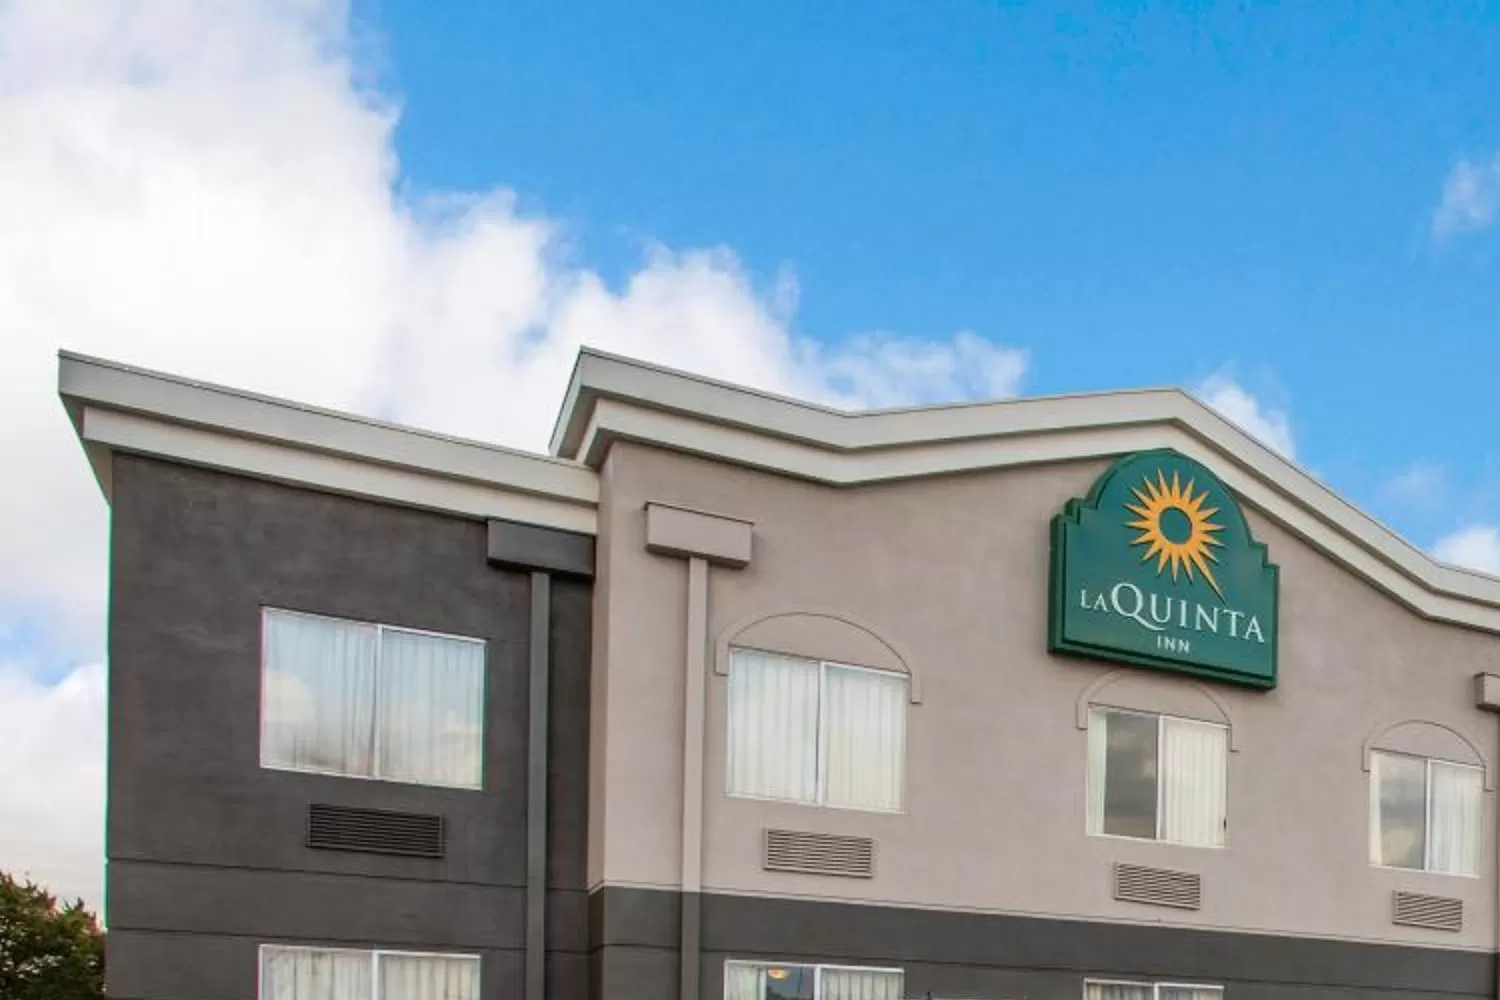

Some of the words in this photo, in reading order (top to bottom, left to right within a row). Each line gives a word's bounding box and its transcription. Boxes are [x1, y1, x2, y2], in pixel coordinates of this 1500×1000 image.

[1080, 589, 1109, 613] LA
[1111, 582, 1265, 643] QUINTA
[1157, 635, 1190, 654] INN
